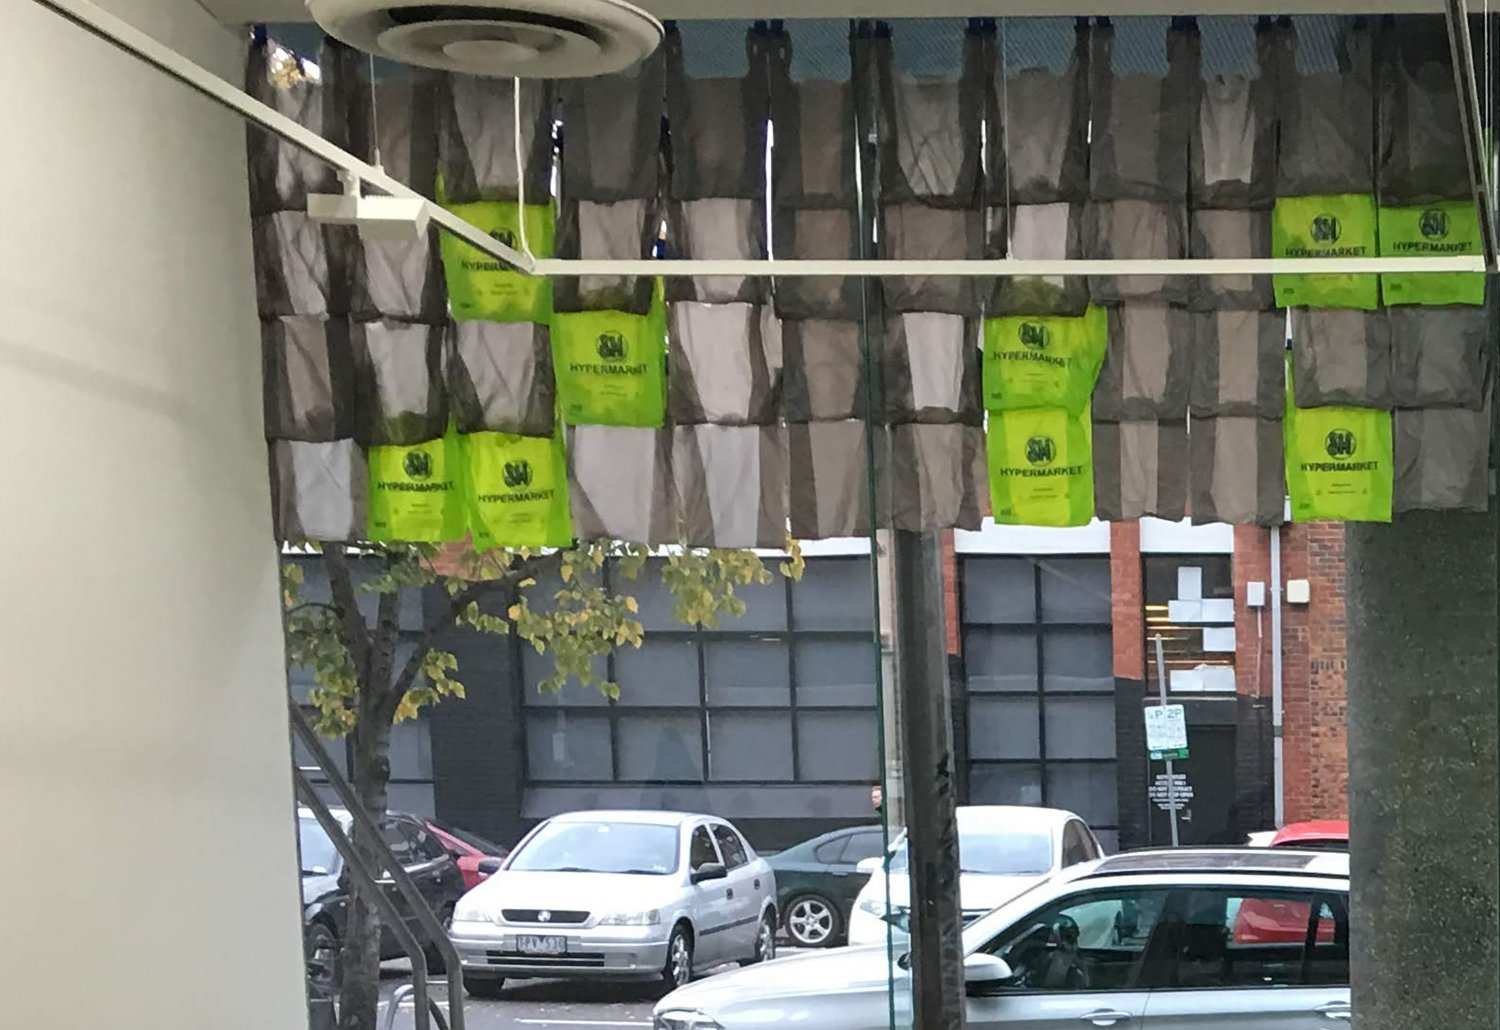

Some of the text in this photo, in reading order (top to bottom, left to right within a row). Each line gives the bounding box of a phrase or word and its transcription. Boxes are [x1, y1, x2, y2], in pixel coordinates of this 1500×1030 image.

[1285, 246, 1366, 256] HYPERMARKET
[1393, 241, 1472, 252] HYPERMARKET
[993, 351, 1071, 368] HYPERMARKET
[570, 363, 647, 374] HYPERMARKET
[1000, 465, 1083, 477] HYPERMARKET
[1301, 461, 1379, 471] HYPERMARKET
[377, 481, 454, 492] HYPERMARKET
[478, 489, 555, 502] HYPERMARKET
